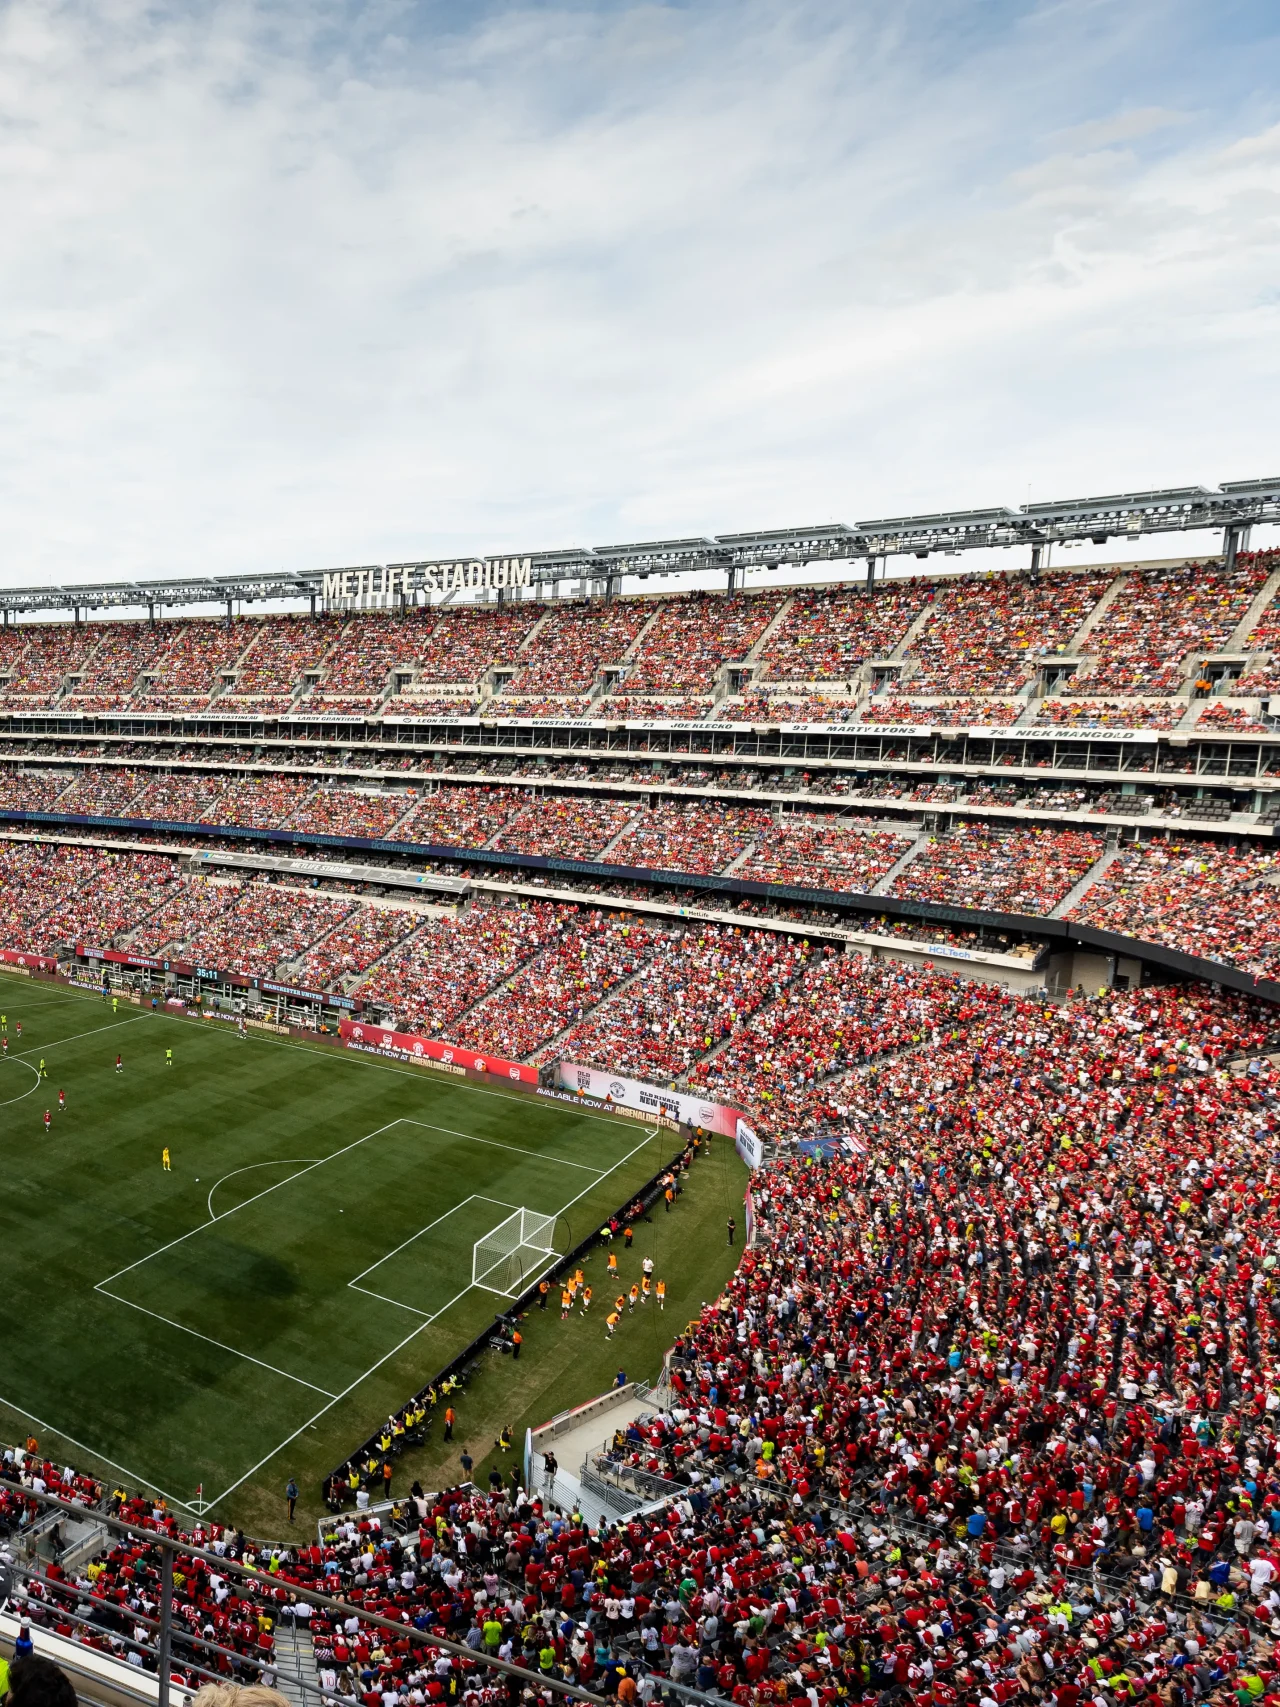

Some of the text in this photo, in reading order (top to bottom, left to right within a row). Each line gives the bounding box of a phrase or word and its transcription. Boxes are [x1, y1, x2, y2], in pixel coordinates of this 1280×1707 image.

[323, 568, 416, 599] METLIFE
[424, 558, 532, 593] STADIUM
[1057, 730, 1135, 739] MANGOLD
[88, 816, 132, 827] ticketmaster
[152, 821, 198, 833] ticketmaster
[220, 826, 270, 838] ticketmaster
[293, 833, 345, 846] ticketmaster
[371, 840, 429, 854] ticketmaster
[455, 847, 518, 864] ticketmaster
[290, 861, 353, 874] METLIFE STADIUM
[547, 858, 615, 875] ticketmaster
[426, 877, 454, 886] MetLife
[651, 870, 729, 889] ticketmaster
[766, 884, 855, 906] ticketmaster
[688, 910, 709, 918] MetLife
[818, 930, 848, 940] verizon
[928, 946, 971, 958] HCLTech
[127, 956, 158, 967] ARSENAL
[164, 962, 169, 970] 0
[196, 968, 218, 980] 35:11
[253, 979, 258, 988] 1
[263, 983, 300, 996] MANCHESTER
[301, 990, 323, 1001] UNITED
[221, 1012, 235, 1022] NOW
[347, 1041, 466, 1076] AVAILABLE NOW AT ARSENALDIRECT.COM
[577, 1077, 591, 1086] NEW
[536, 1087, 579, 1104] AVAILABLE
[580, 1098, 602, 1110] NOW
[603, 1103, 614, 1112] AT
[640, 1090, 654, 1098] OLD
[639, 1095, 658, 1107] NEW
[194, 1532, 202, 1541] 18
[212, 1526, 218, 1537] 7
[633, 1529, 641, 1537] 29
[230, 1549, 236, 1558] 9
[548, 1577, 556, 1585] 10
[852, 1621, 859, 1631] 7
[325, 1676, 334, 1687] 10
